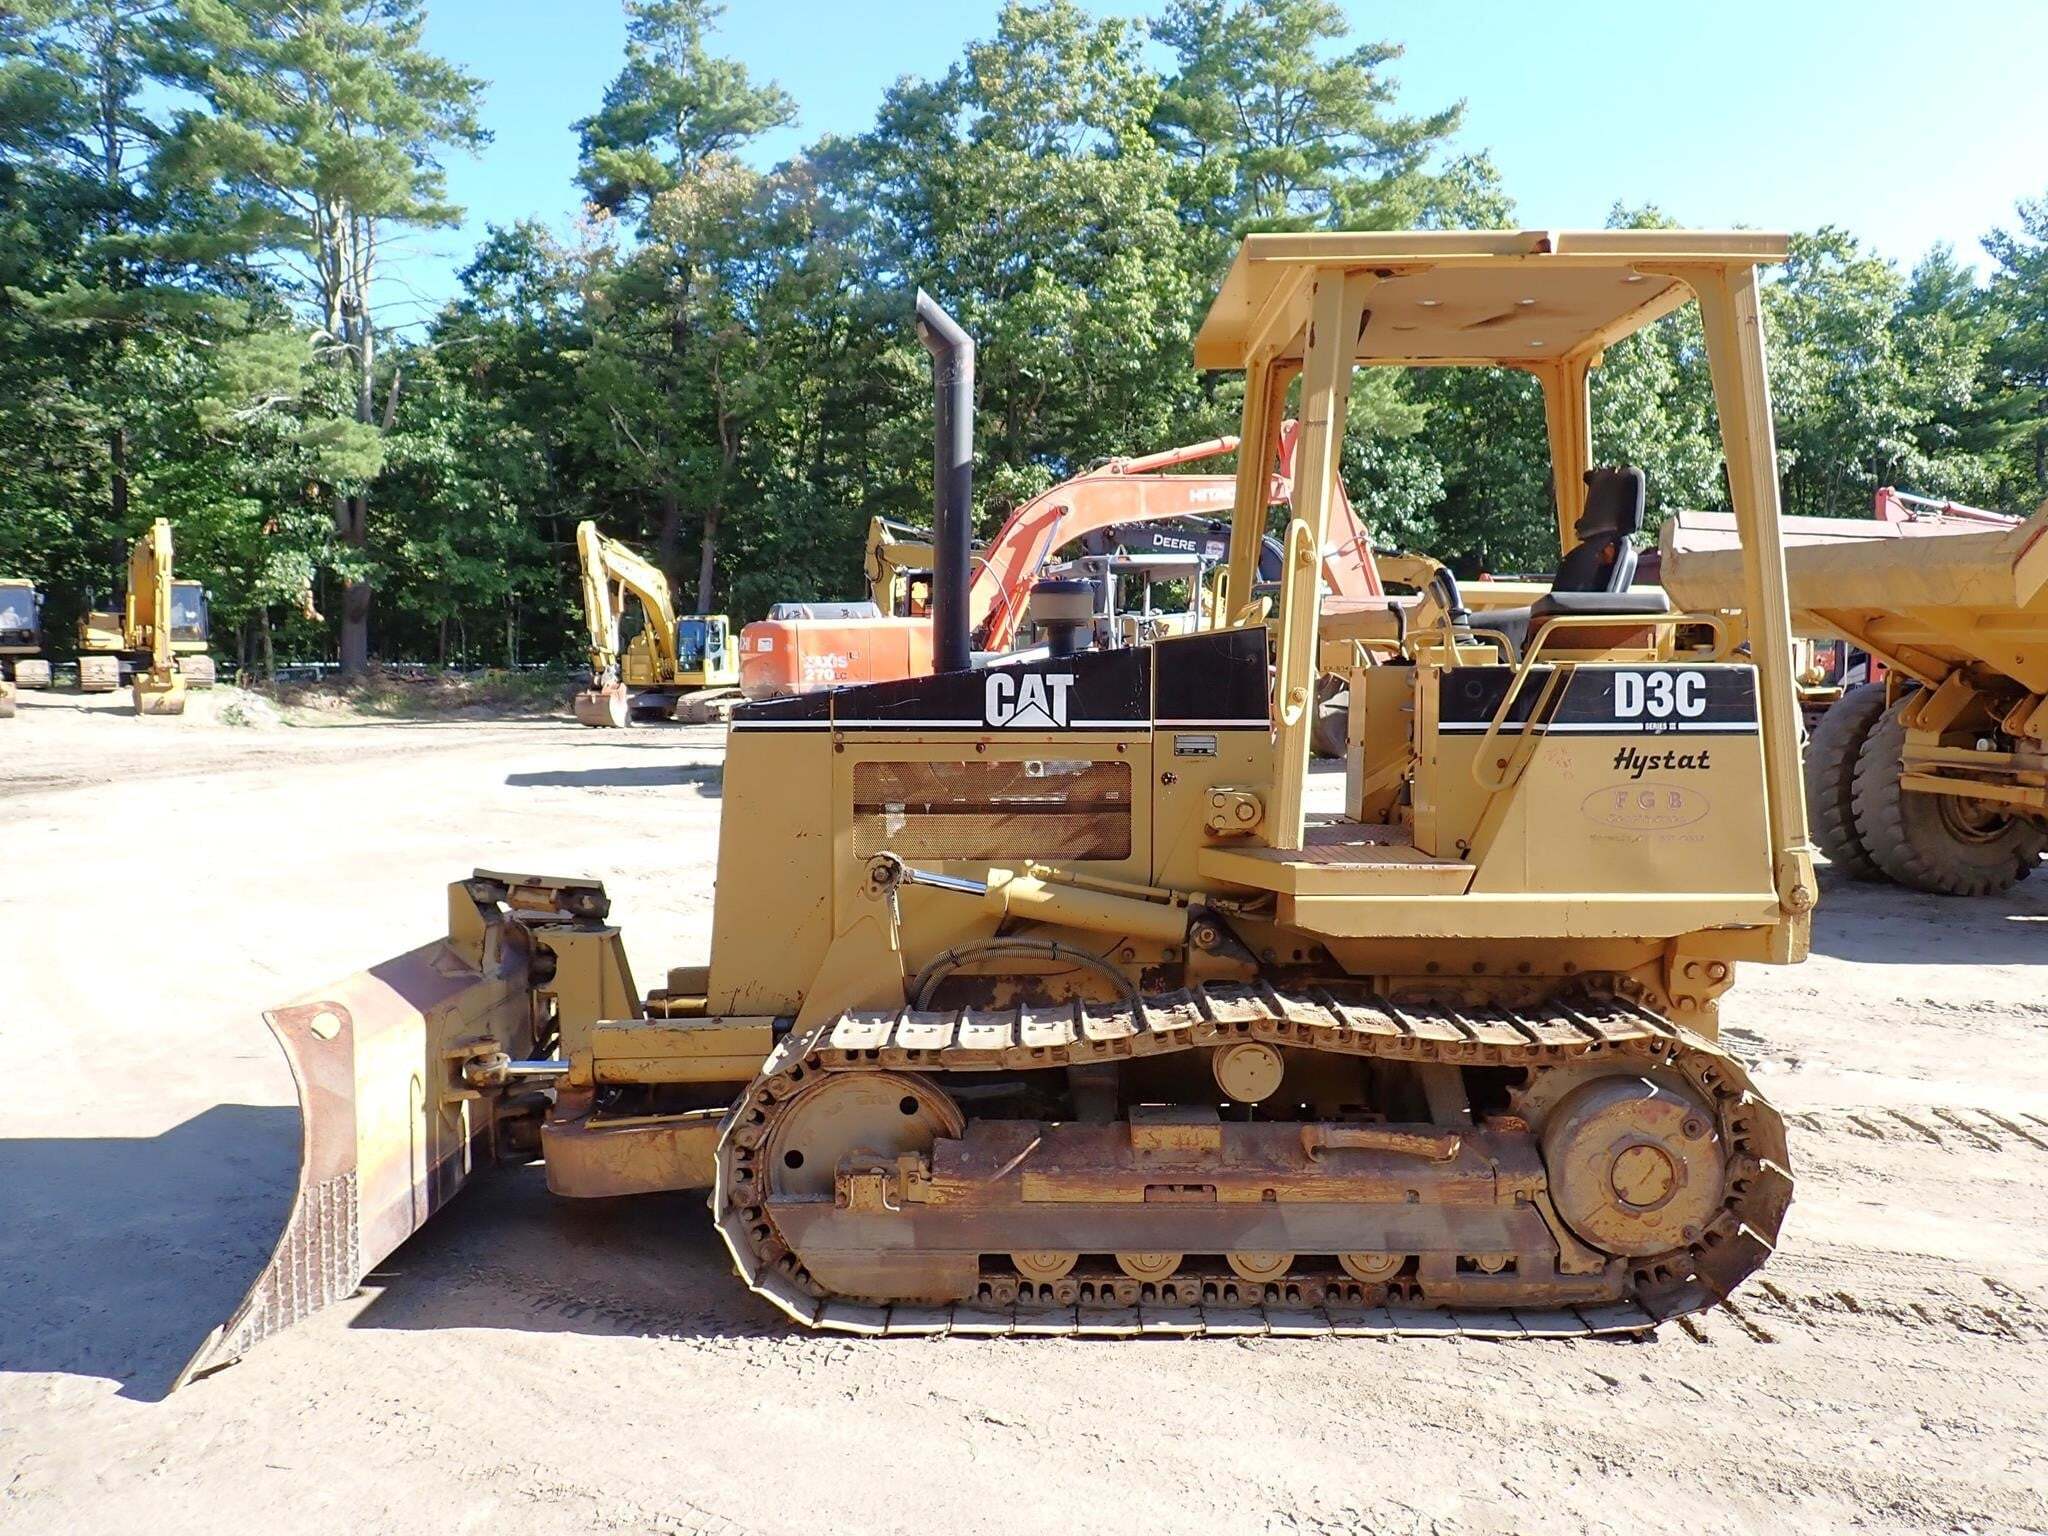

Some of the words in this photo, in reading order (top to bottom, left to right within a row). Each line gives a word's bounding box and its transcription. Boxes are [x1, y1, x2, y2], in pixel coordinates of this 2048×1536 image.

[1153, 534, 1196, 550] DEERE
[986, 673, 1074, 727] CAT
[1615, 672, 1706, 717] D3C
[1645, 722, 1667, 730] SERIES
[1614, 747, 1710, 778] Hystat
